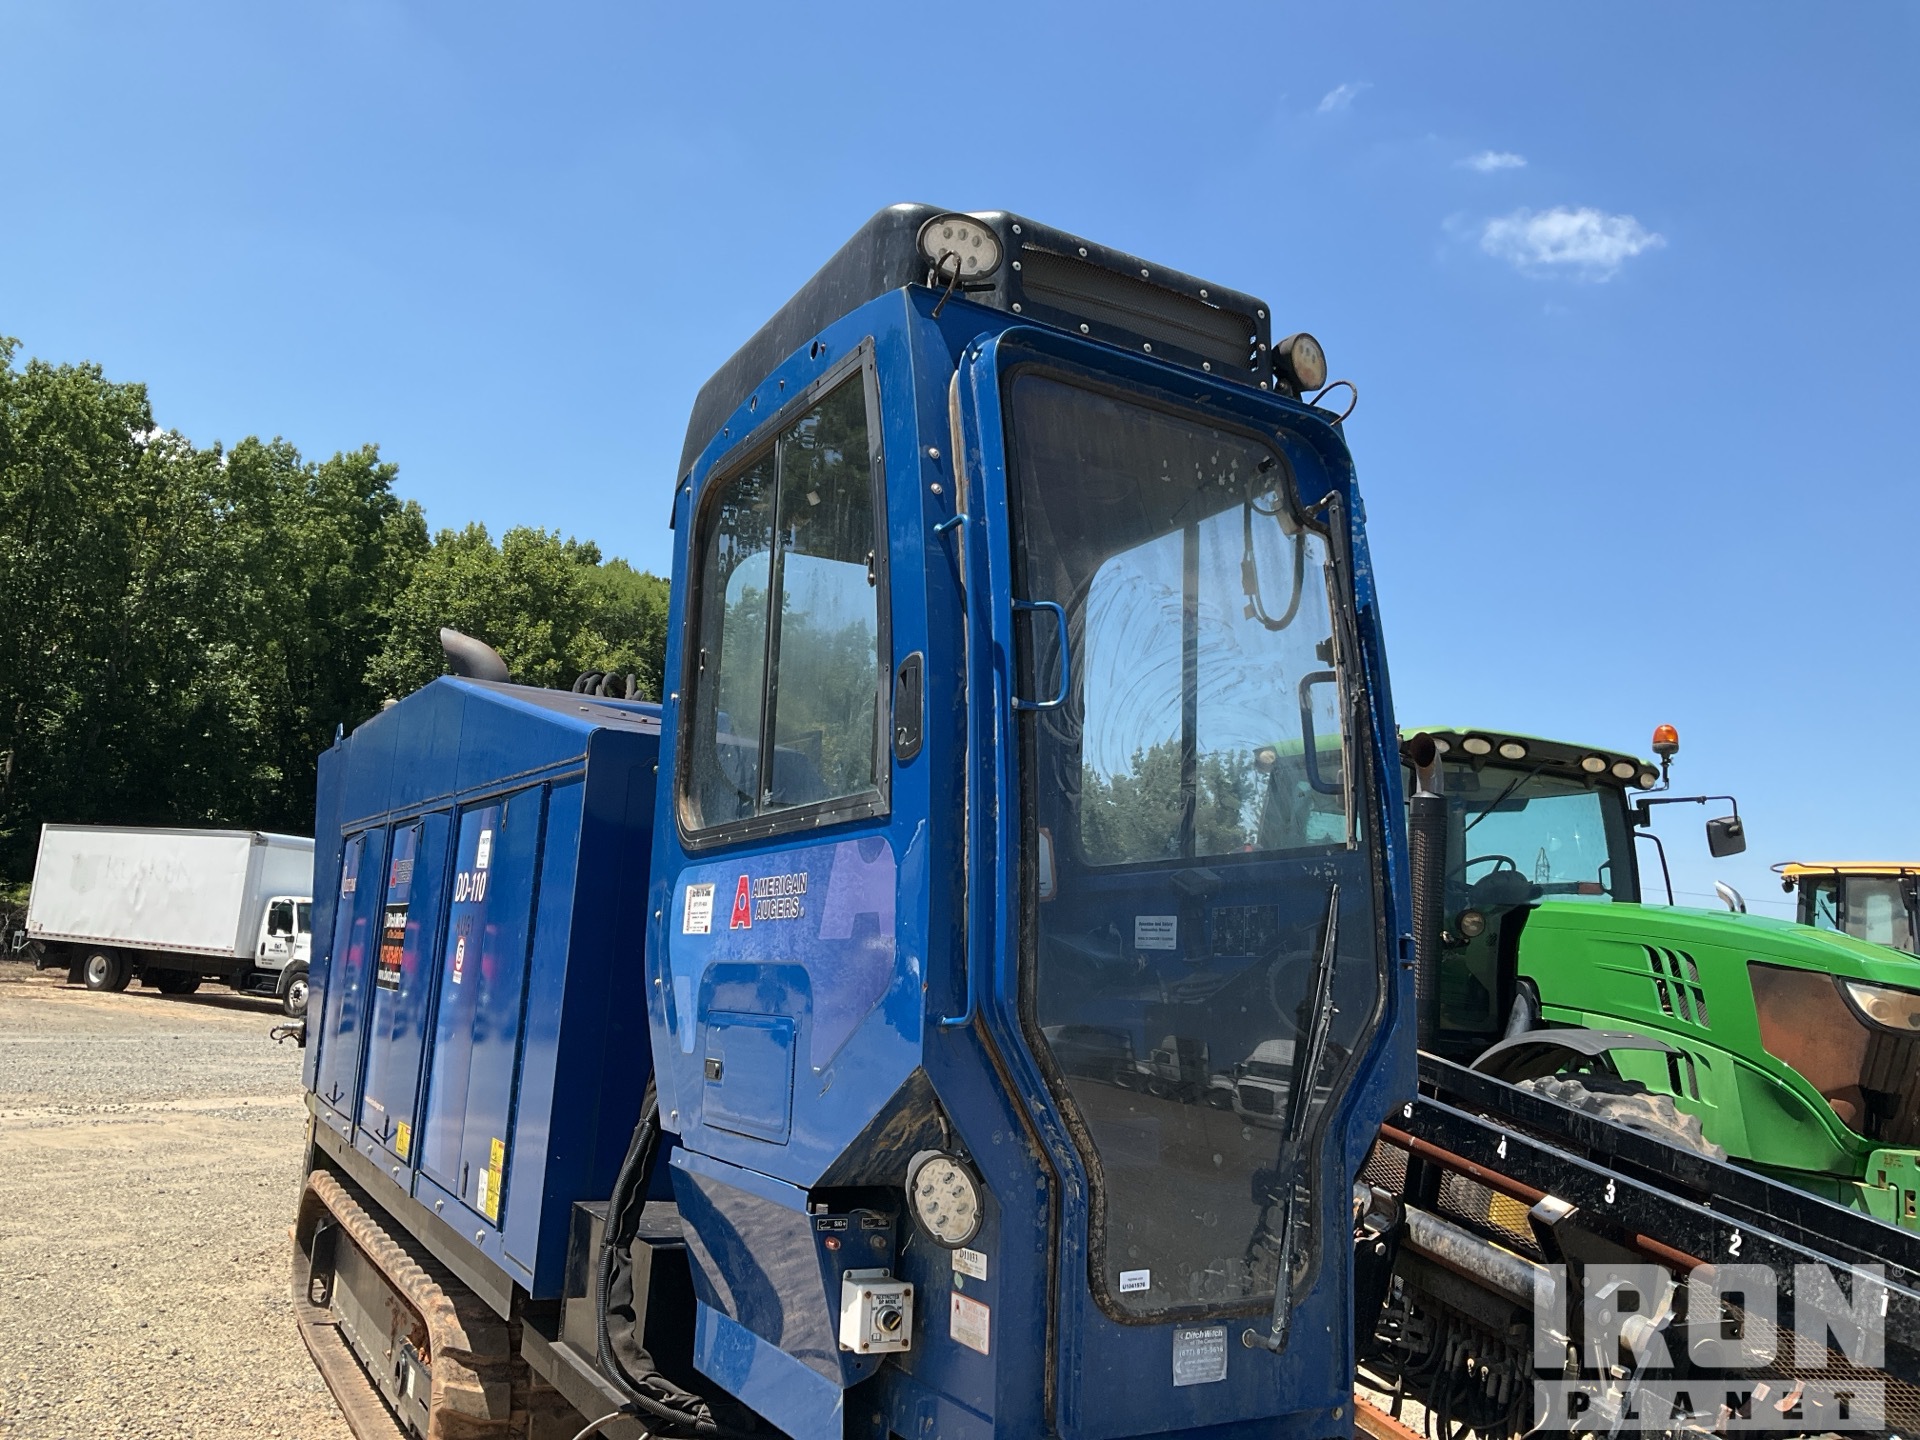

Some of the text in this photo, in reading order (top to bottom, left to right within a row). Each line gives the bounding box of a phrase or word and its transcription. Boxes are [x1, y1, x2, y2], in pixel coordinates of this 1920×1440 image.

[455, 871, 487, 902] DD-110
[752, 872, 808, 898] AMERICAN
[755, 896, 800, 920] AUGERS
[1404, 1104, 1412, 1118] 5
[1496, 1140, 1507, 1160] 4
[1605, 1182, 1616, 1204] 3
[1728, 1232, 1743, 1256] 2
[1881, 1295, 1889, 1318] 1
[1185, 1330, 1223, 1340] Ditch Witch
